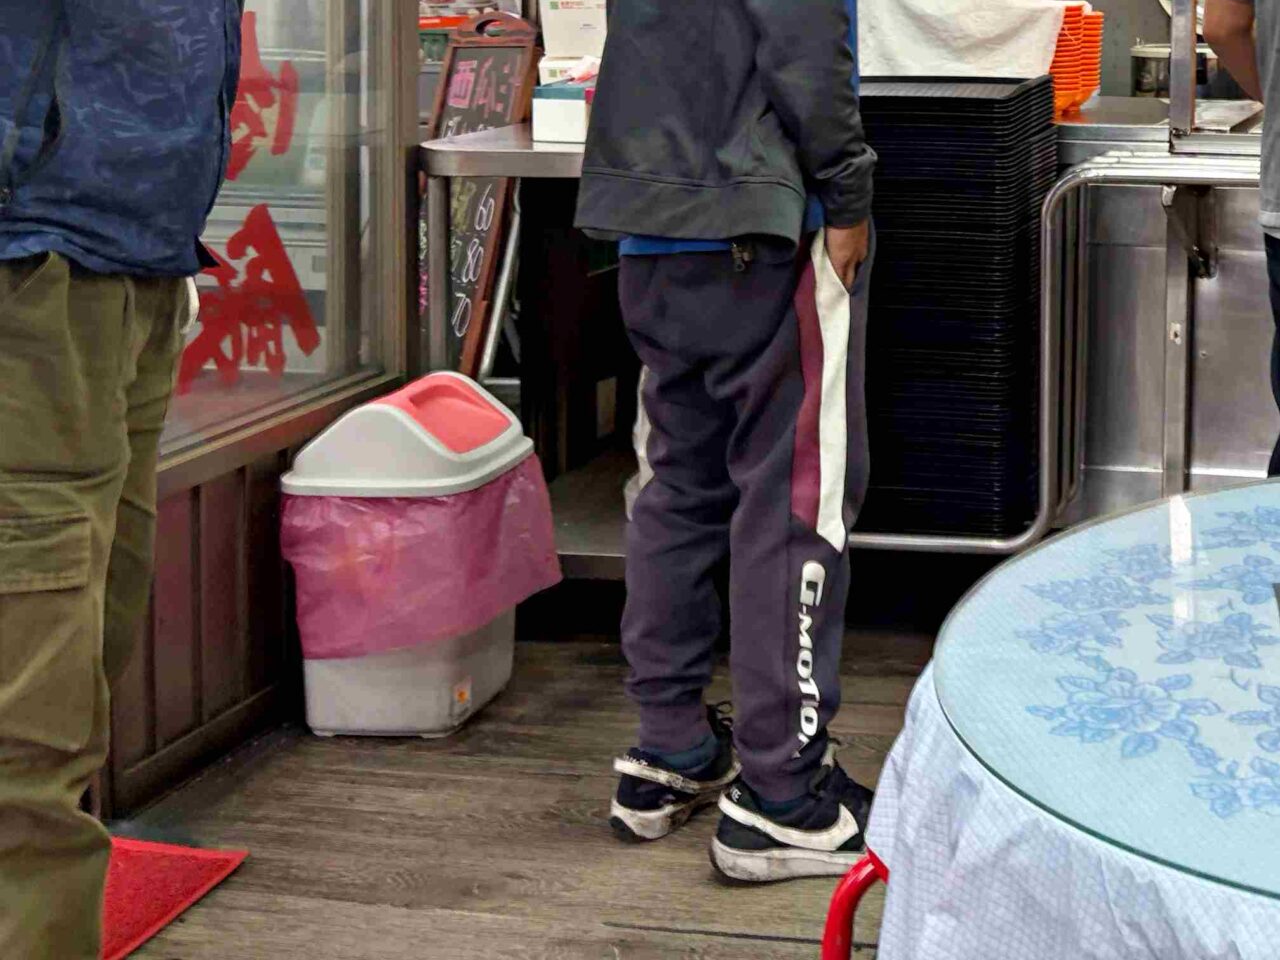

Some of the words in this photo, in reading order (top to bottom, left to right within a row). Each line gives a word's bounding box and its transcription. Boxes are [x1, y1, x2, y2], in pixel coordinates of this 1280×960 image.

[475, 183, 495, 231] 60
[462, 238, 484, 283] 80
[451, 292, 472, 338] 70
